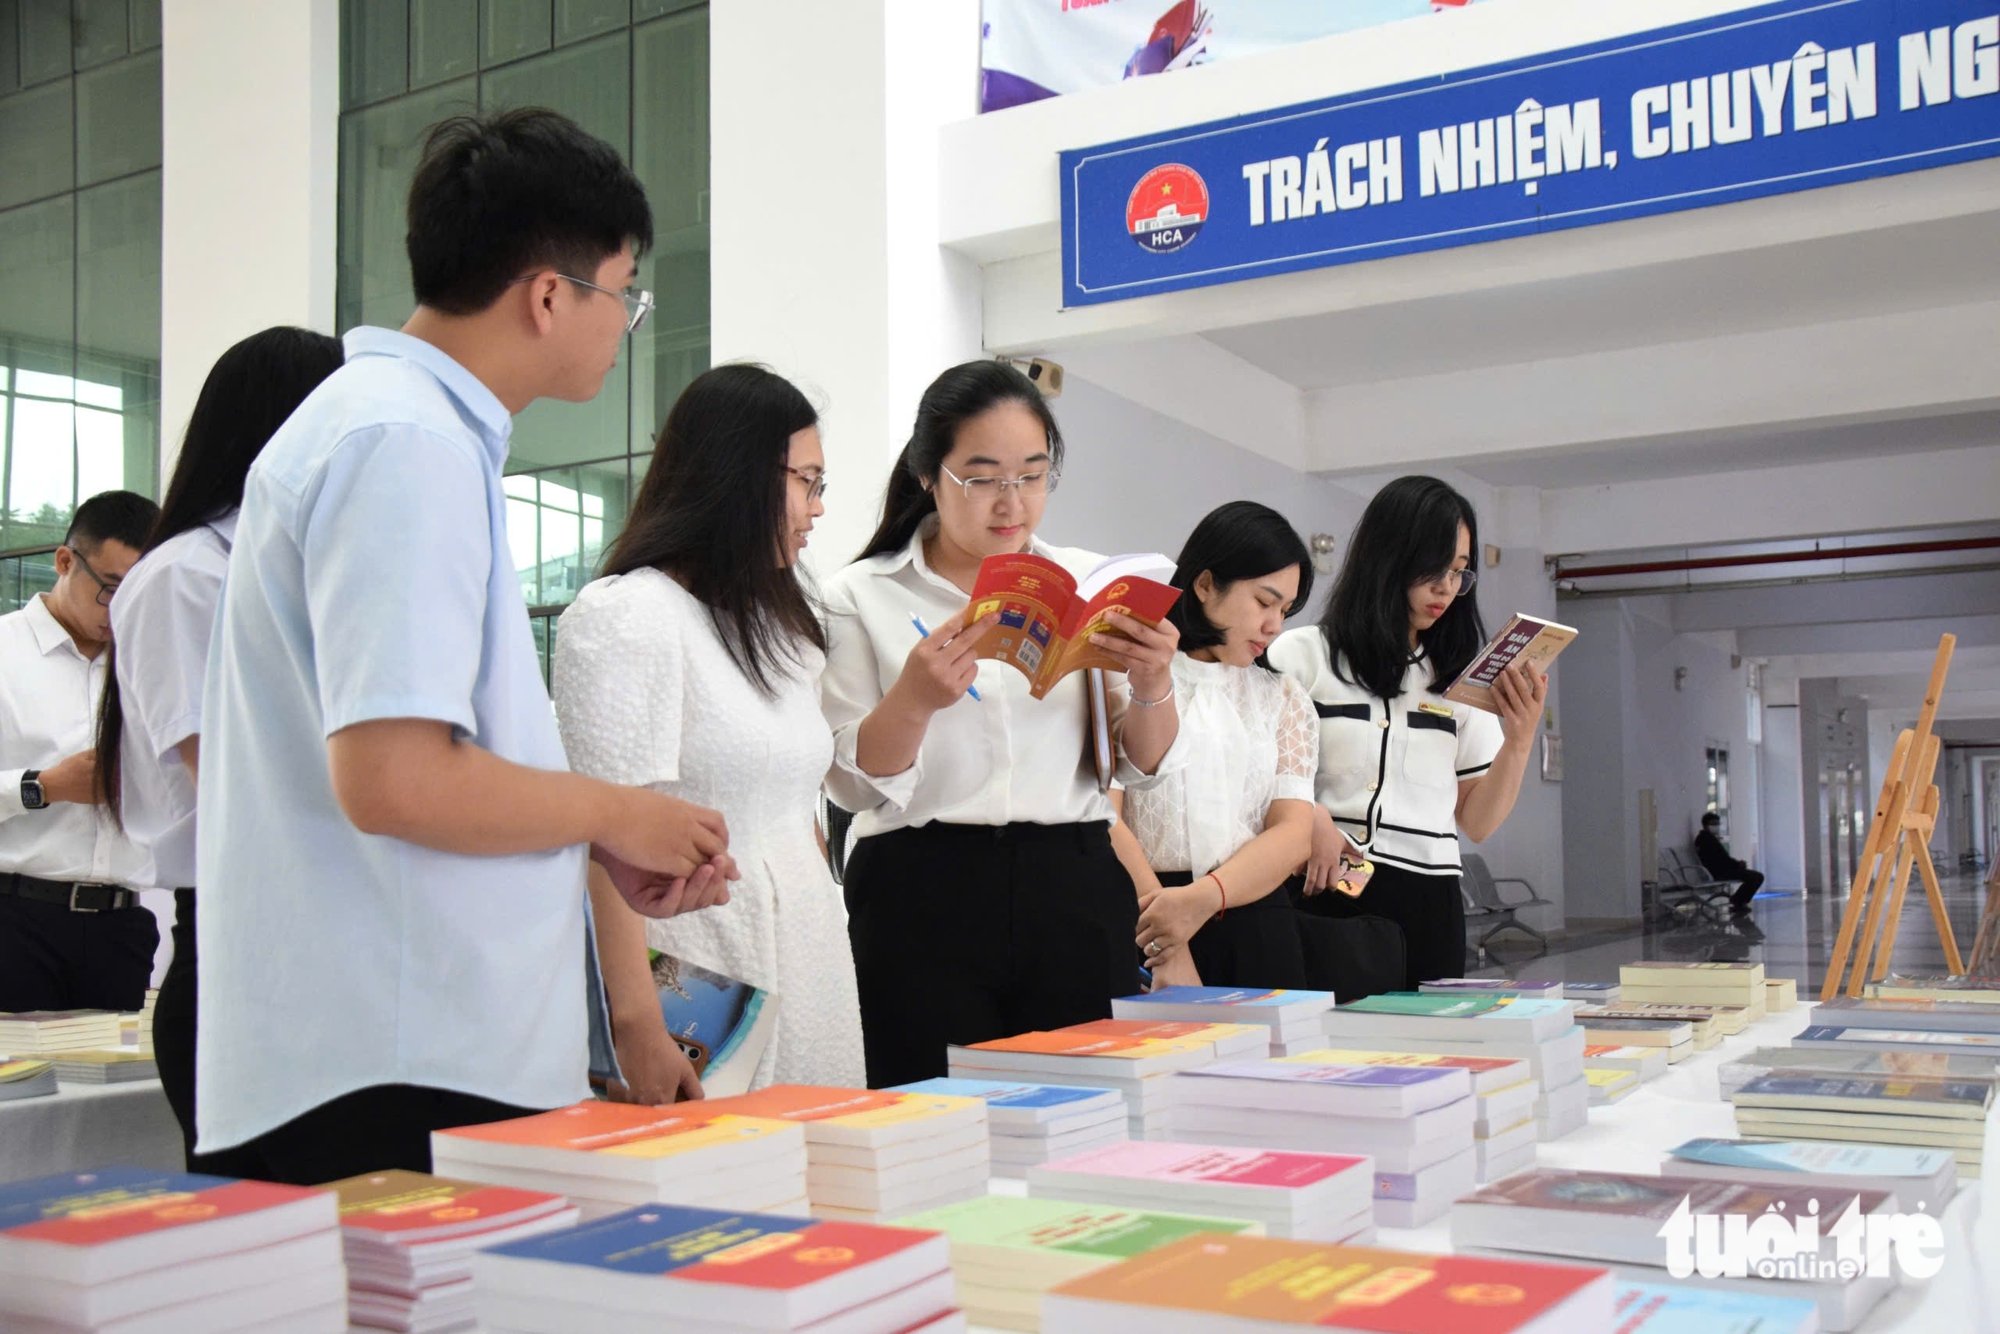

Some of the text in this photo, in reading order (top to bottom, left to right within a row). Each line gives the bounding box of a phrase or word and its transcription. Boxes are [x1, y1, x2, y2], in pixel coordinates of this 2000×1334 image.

[1242, 137, 1403, 226] TRÁCH
[1418, 97, 1618, 197] NHIỆM,
[1631, 41, 1877, 159] CHUYÊN
[1899, 15, 2000, 111] NG
[1151, 228, 1183, 246] HCA
[1508, 632, 1530, 644] BẢN
[1503, 643, 1521, 653] ÁN
